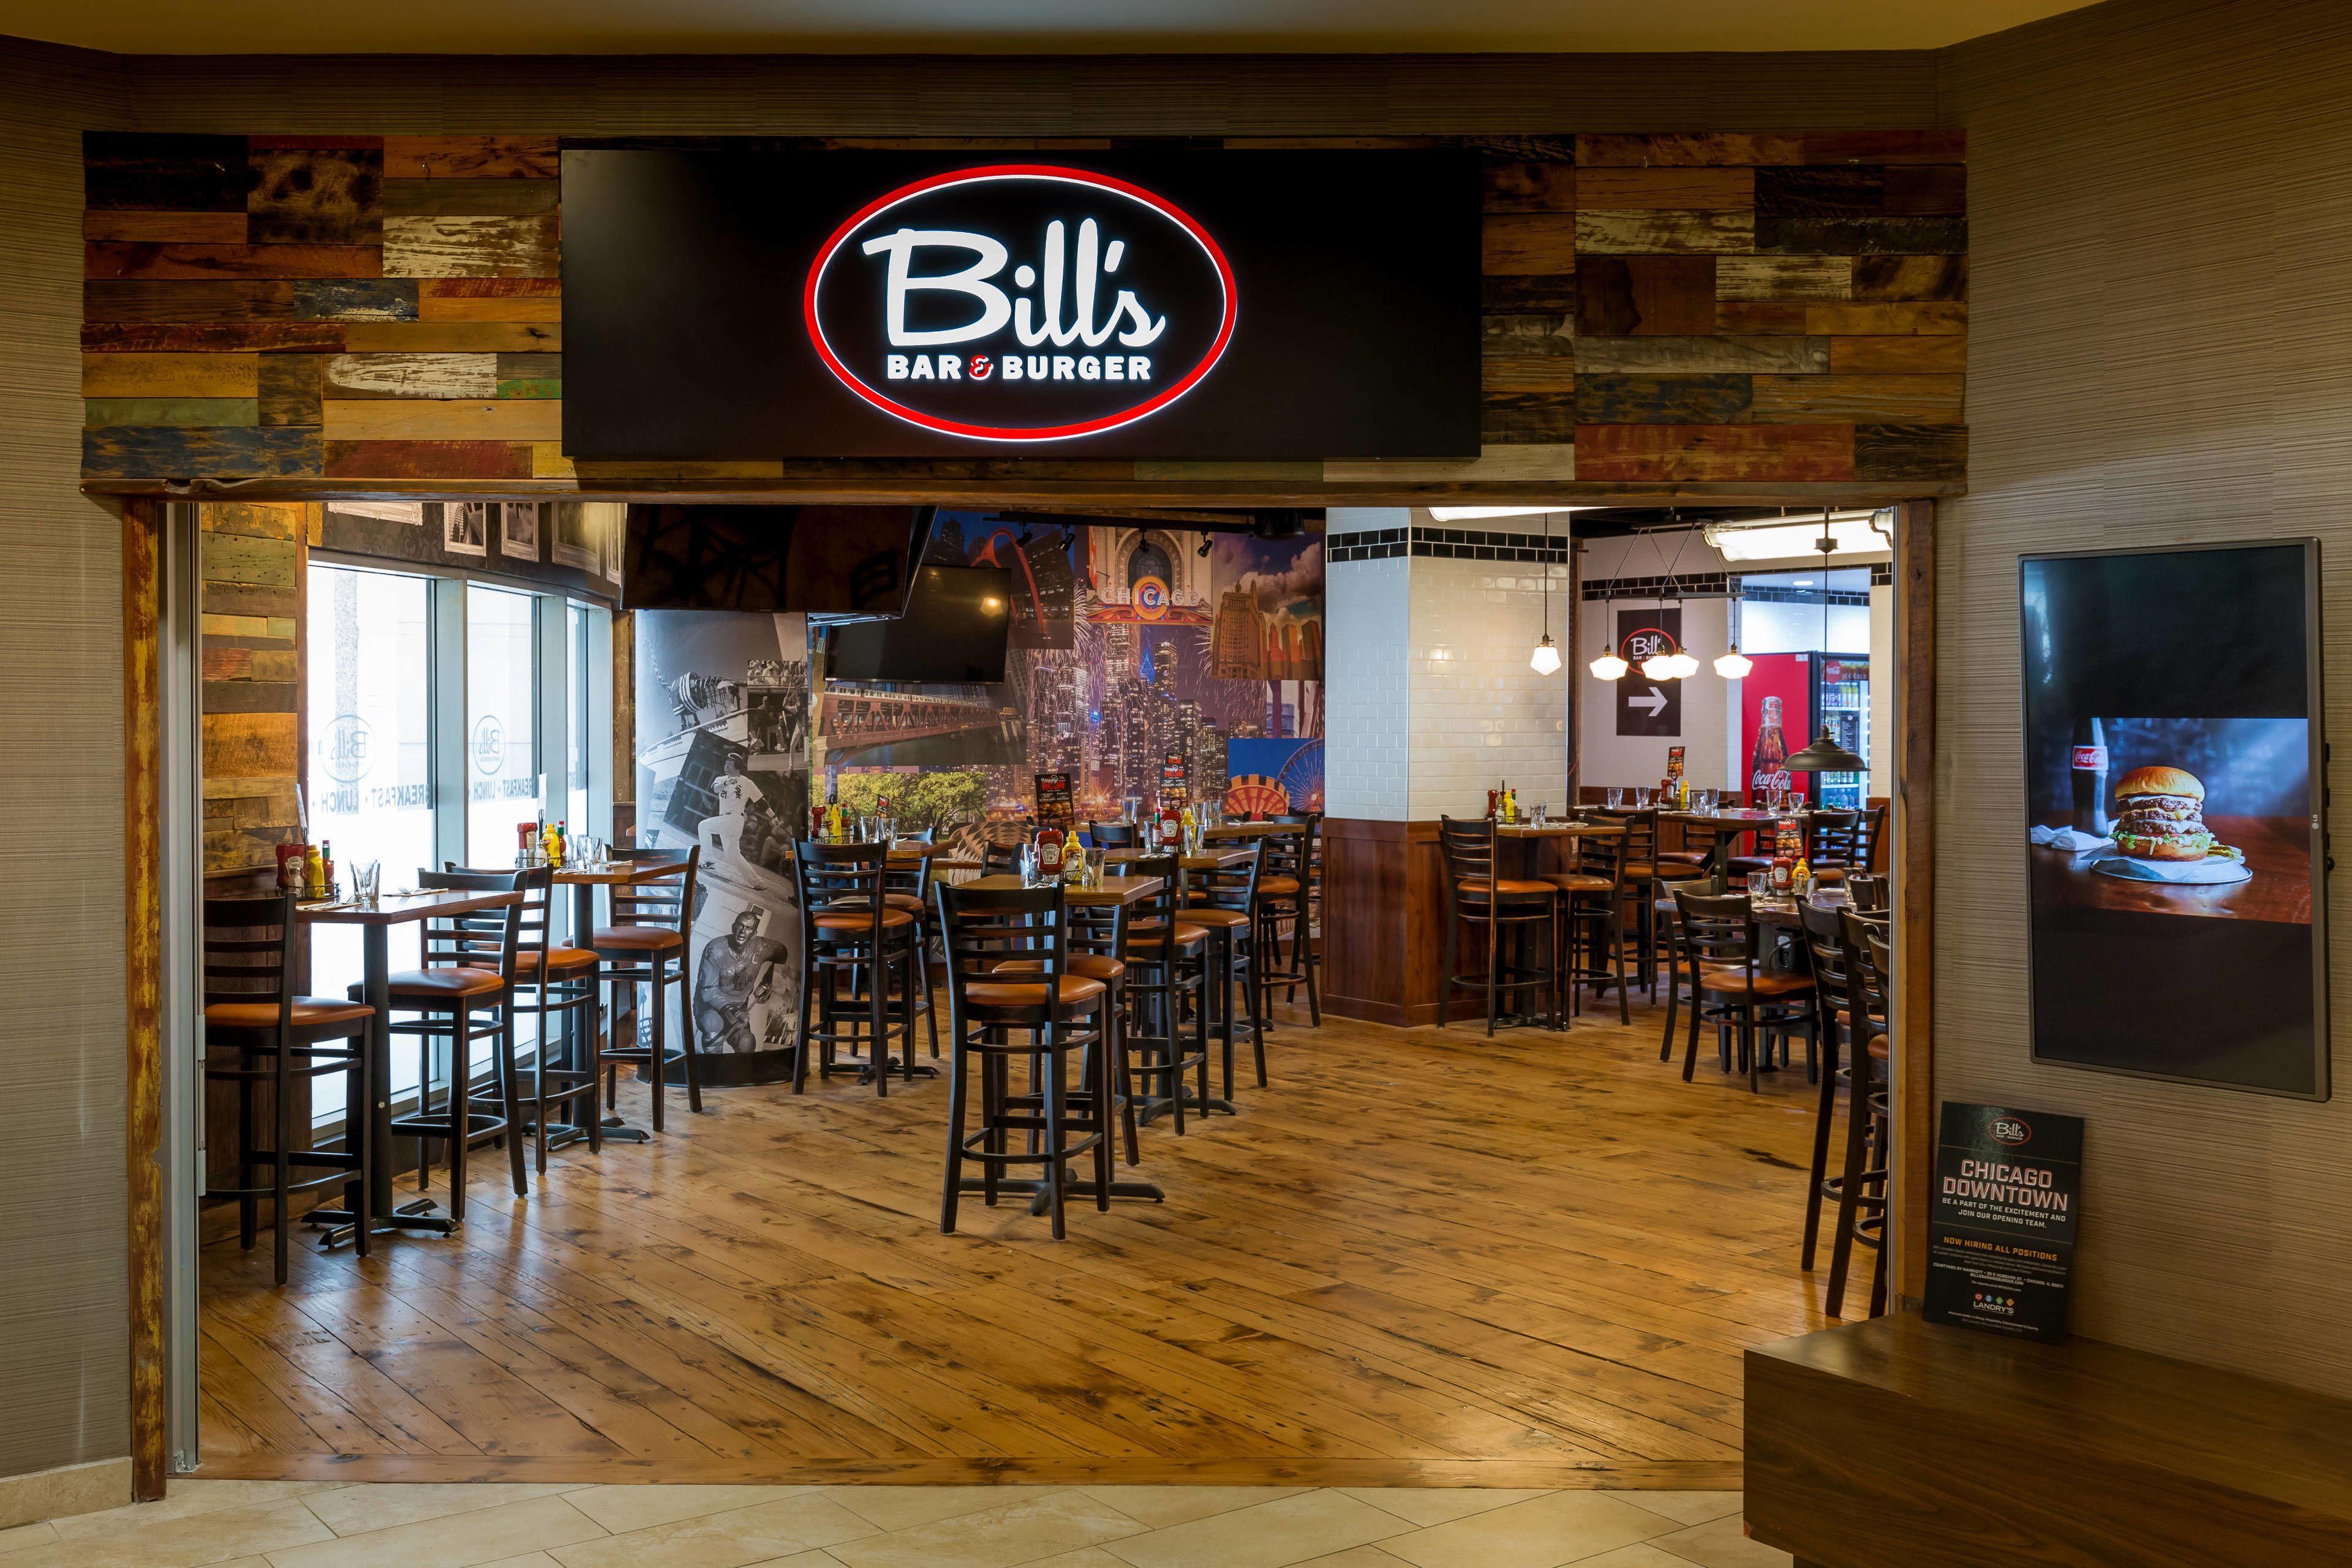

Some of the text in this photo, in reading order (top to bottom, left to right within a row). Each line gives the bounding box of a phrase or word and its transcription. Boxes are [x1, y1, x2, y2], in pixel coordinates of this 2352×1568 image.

[862, 218, 1165, 347] Bill's
[887, 355, 1151, 380] BAR & BURGER
[1102, 587, 1200, 606] CHICAGO
[1994, 1122, 2024, 1137] Bill's
[1961, 1159, 2052, 1188] CHICAGO
[1943, 1177, 2068, 1212] DOWNTOWN
[1992, 1214, 2024, 1224] OPENING
[2025, 1219, 2047, 1228] TEAM.
[2005, 1207, 2049, 1219] EXCITEMENT
[1943, 1236, 2057, 1262] NOW HIRING ALL POSITIONS
[1973, 1301, 2014, 1314] LANDRY'S
